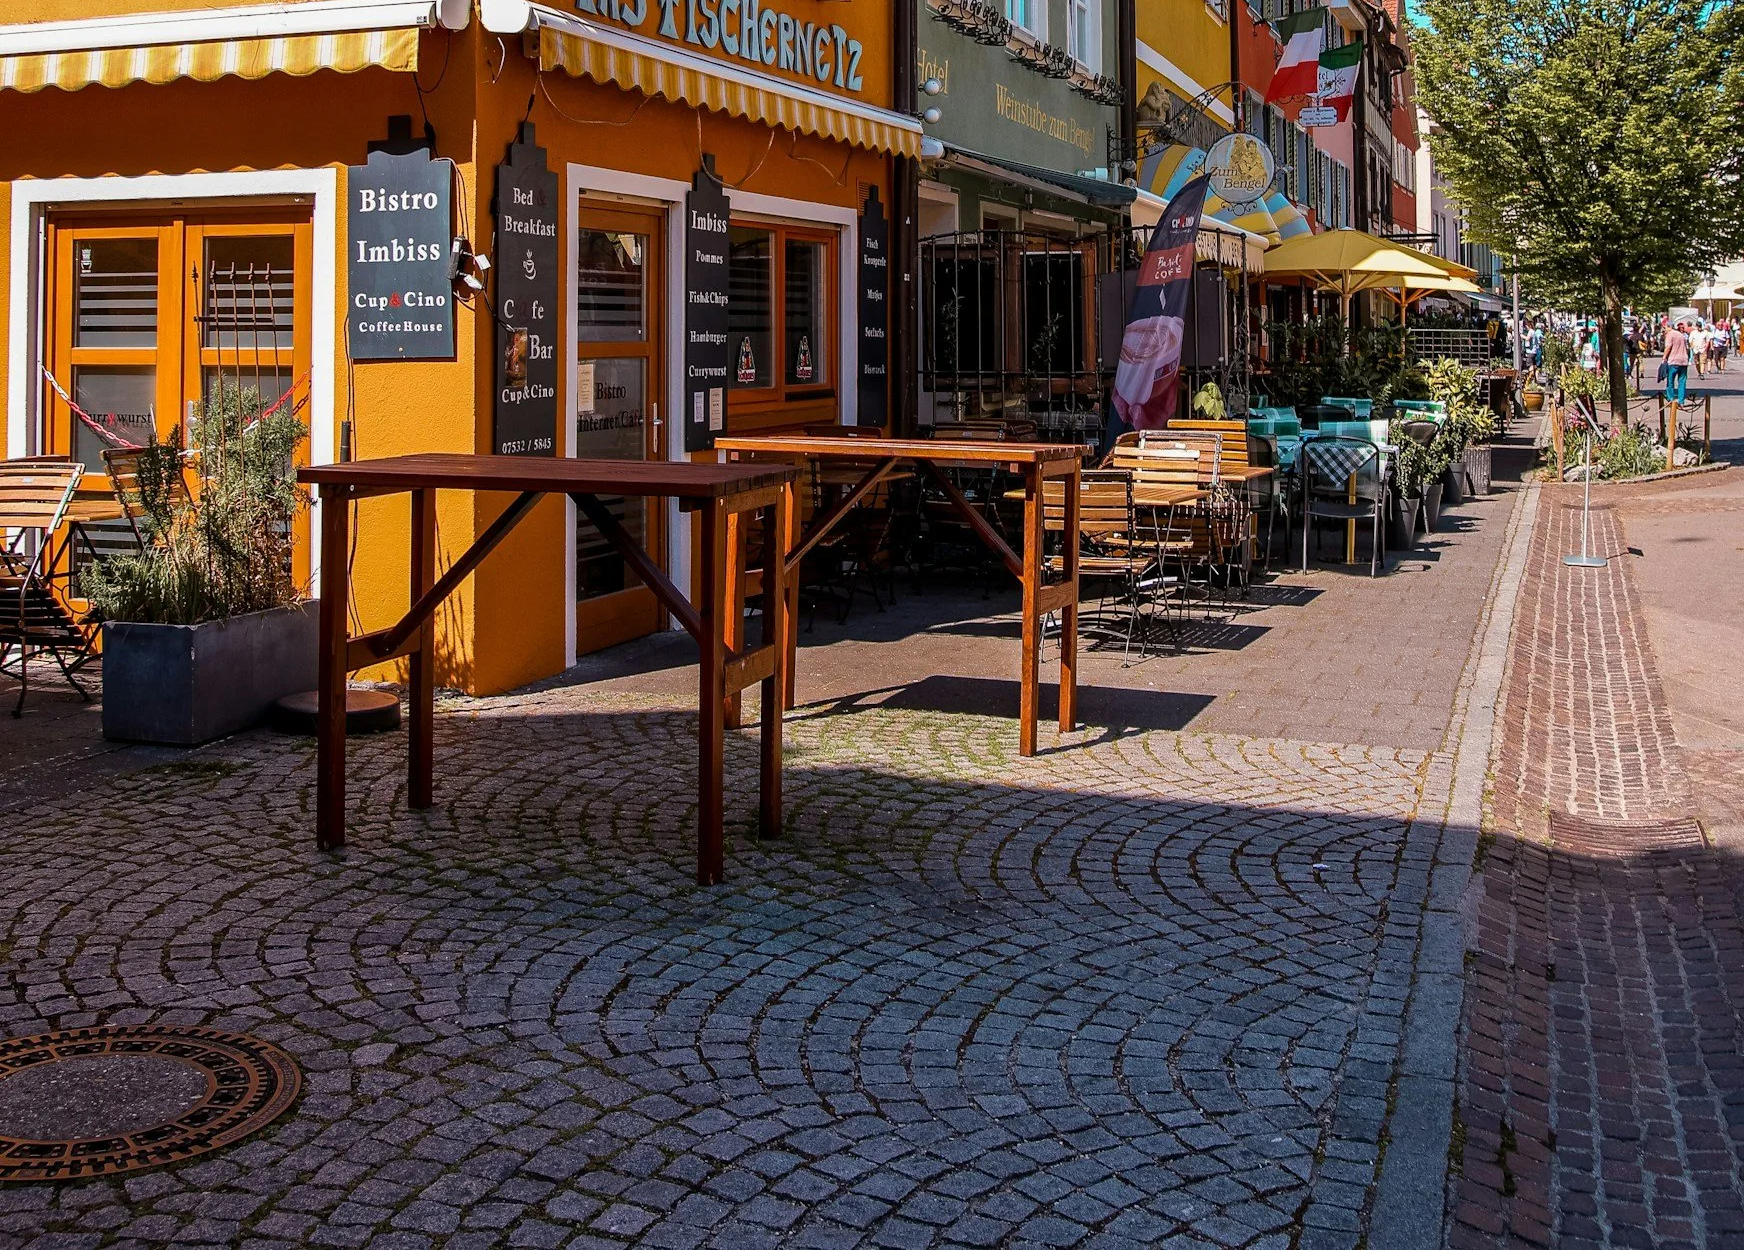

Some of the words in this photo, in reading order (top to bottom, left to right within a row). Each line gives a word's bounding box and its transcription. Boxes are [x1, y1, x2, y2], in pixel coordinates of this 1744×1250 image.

[996, 83, 1047, 134] Weinstube
[1049, 116, 1068, 143] zum
[1210, 166, 1239, 178] Zum
[1224, 178, 1266, 191] Bengel
[359, 188, 438, 213] Bistro
[512, 187, 534, 206] Bed
[504, 215, 556, 237] Breakfast
[691, 210, 727, 234] Imbiss
[356, 238, 441, 263] Imbiss
[866, 237, 879, 250] Fisch
[695, 250, 724, 265] Pommes
[354, 291, 446, 312] Cup&Cino
[689, 291, 729, 307] Fish&Chips
[359, 320, 401, 333] Coffee
[403, 320, 443, 333] House
[529, 334, 553, 360] Bar
[690, 330, 727, 347] Hamburger
[689, 365, 727, 380] Currywurst
[501, 384, 554, 404] Cup&Cino
[596, 381, 627, 400] Bistro
[502, 440, 526, 455] 07532
[533, 437, 552, 452] 5845
